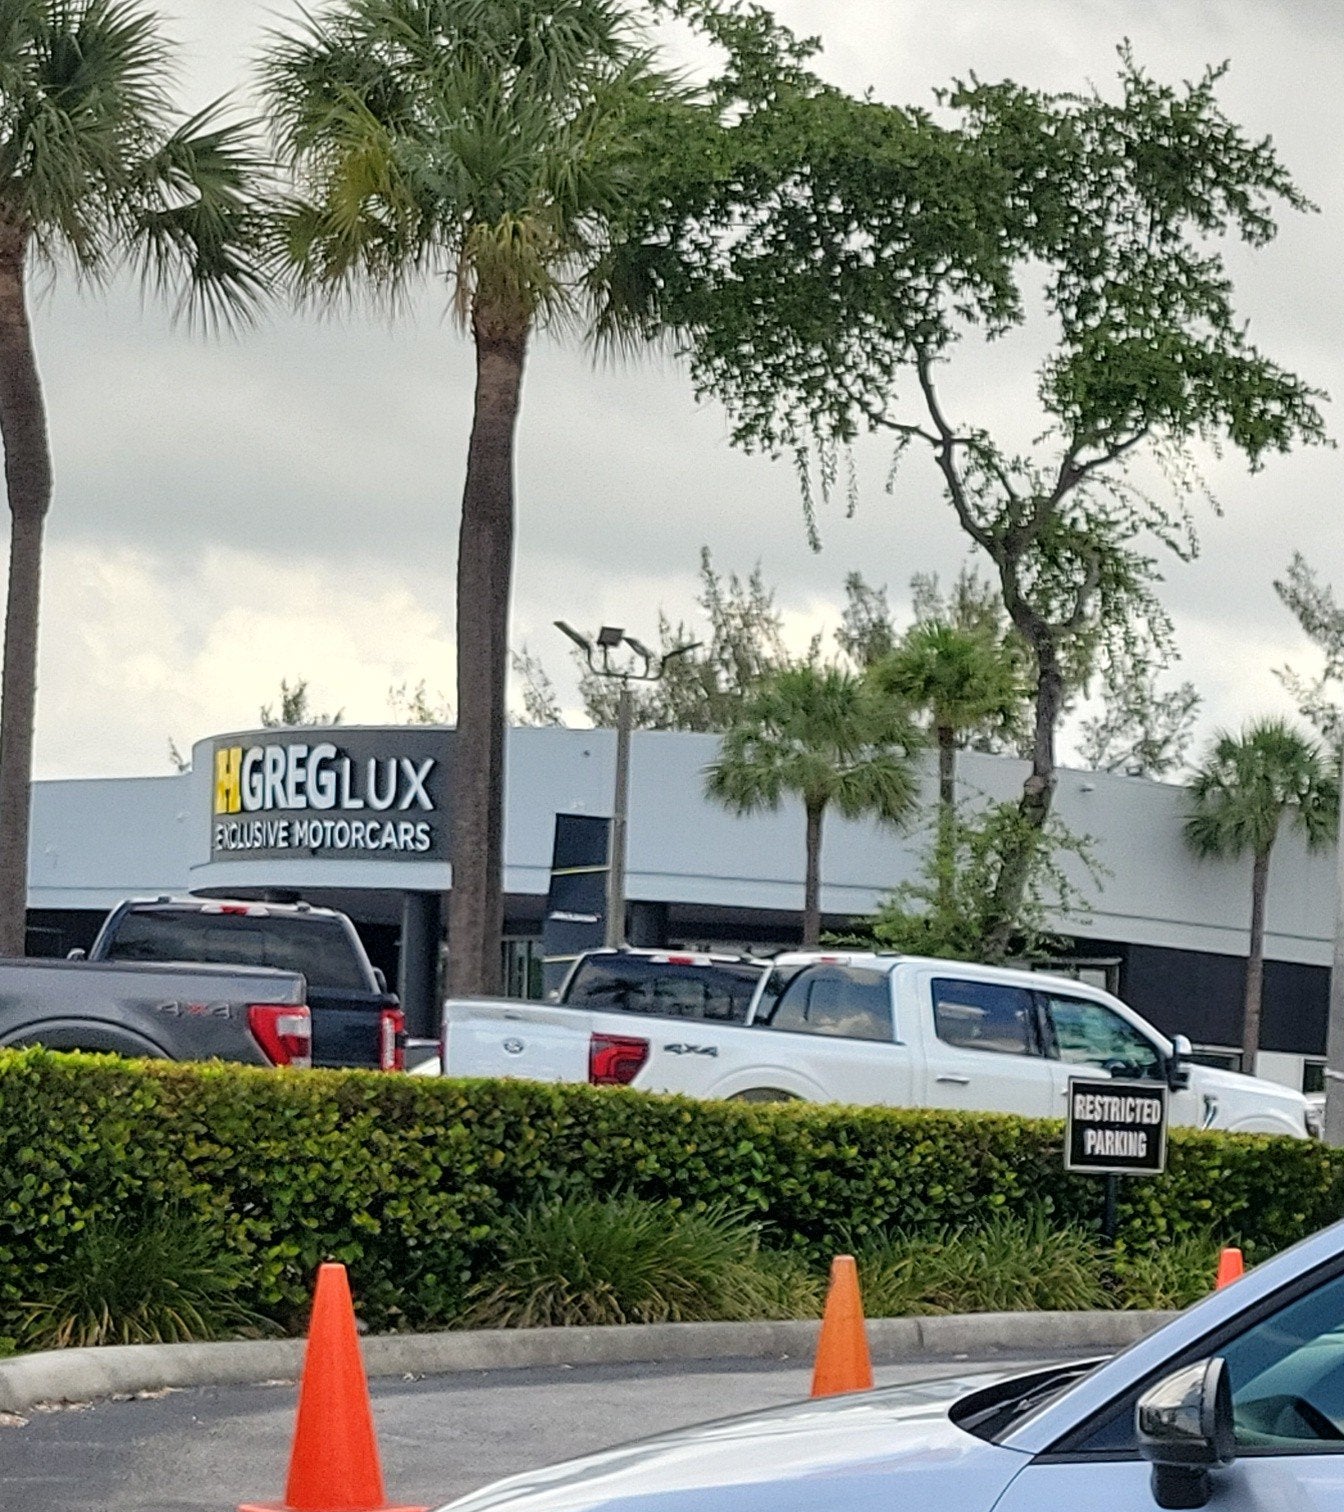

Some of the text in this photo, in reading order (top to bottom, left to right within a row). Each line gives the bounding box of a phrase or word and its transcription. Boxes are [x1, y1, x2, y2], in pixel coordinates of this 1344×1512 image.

[214, 819, 432, 851] EXCLUSIVE MOTORCARS
[1074, 1093, 1161, 1125] RESTRICTED
[1083, 1127, 1148, 1158] PARKING
